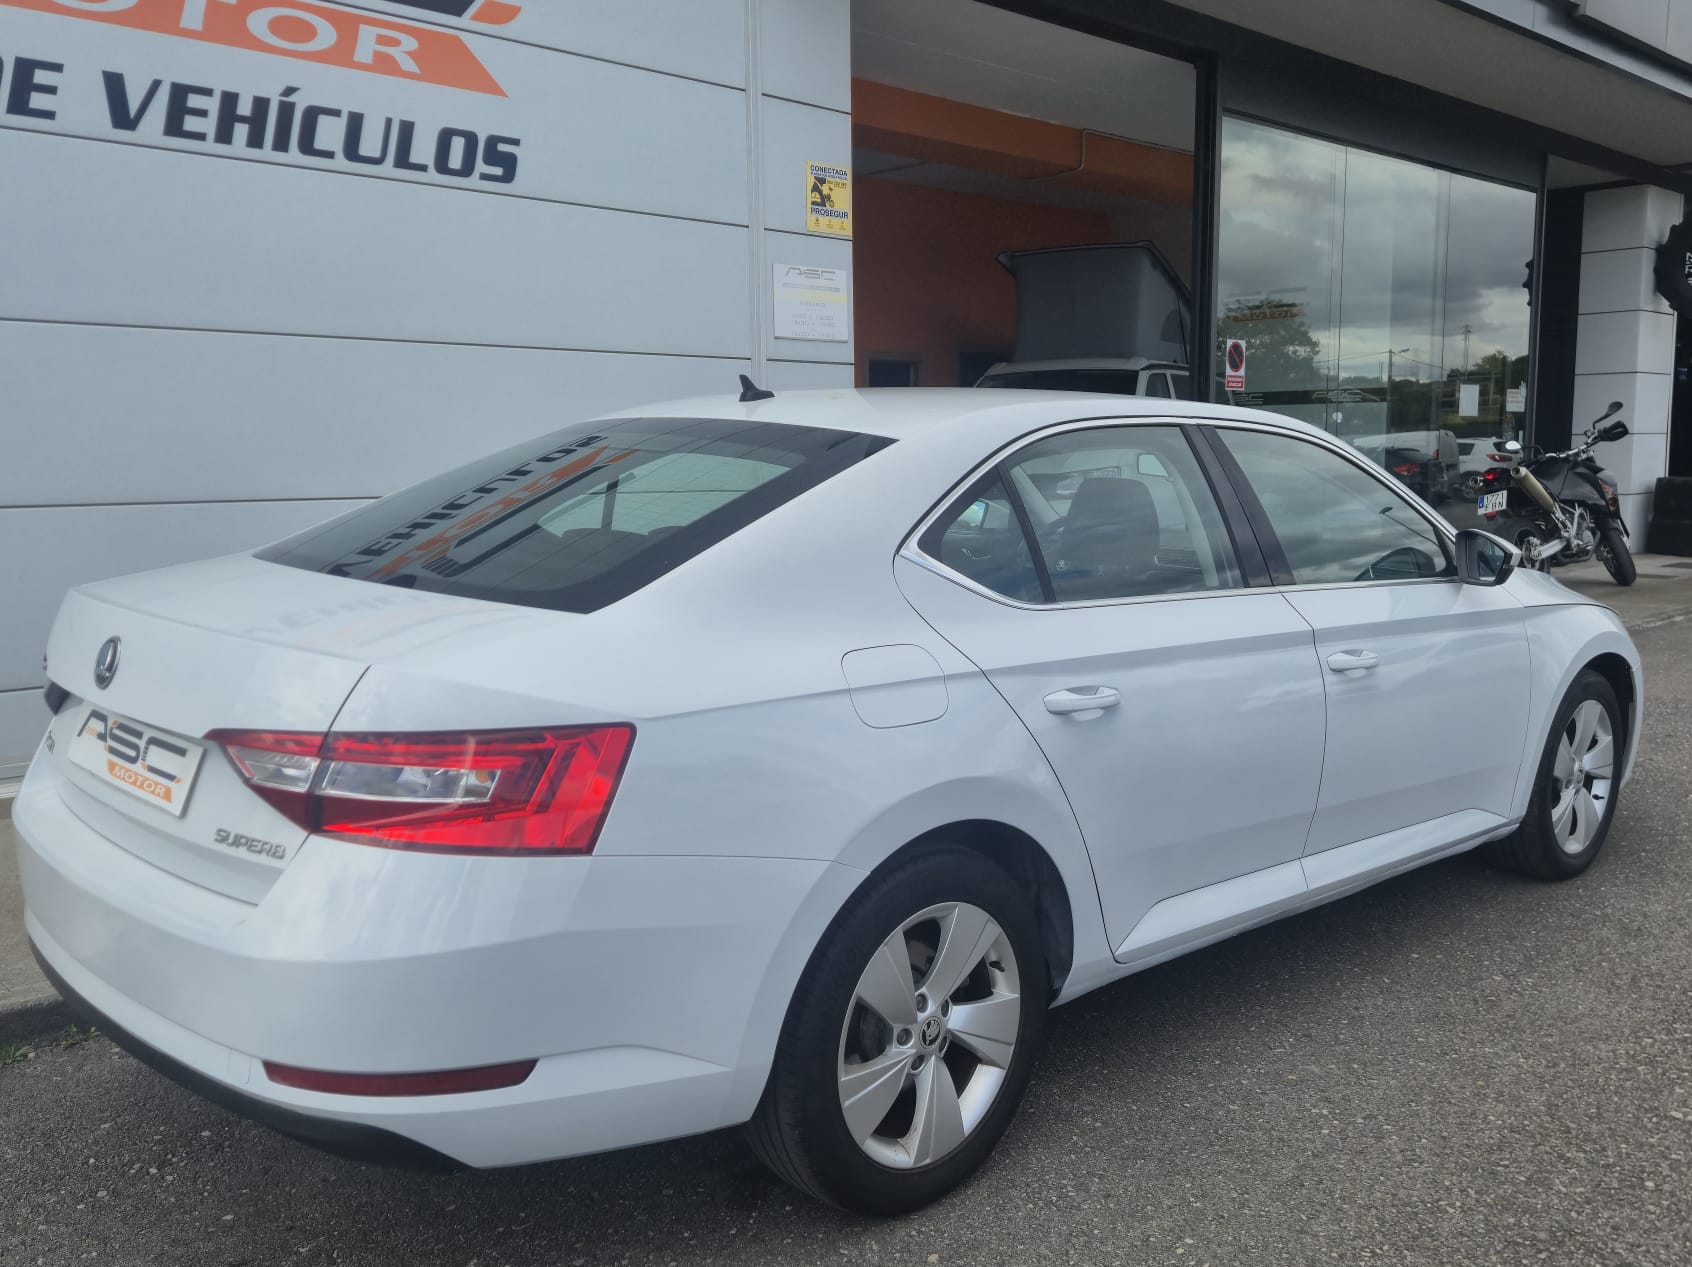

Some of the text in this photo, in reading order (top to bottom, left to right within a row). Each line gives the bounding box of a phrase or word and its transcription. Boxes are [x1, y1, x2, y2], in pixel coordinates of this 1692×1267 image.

[54, 0, 421, 74] TOR
[0, 55, 521, 184] E VEHÍCULOS
[810, 164, 848, 177] CONECTADA
[810, 207, 849, 219] PROSEGUR
[77, 709, 188, 784] ASC
[112, 764, 166, 798] MOTOR
[214, 828, 287, 860] SUPERB
